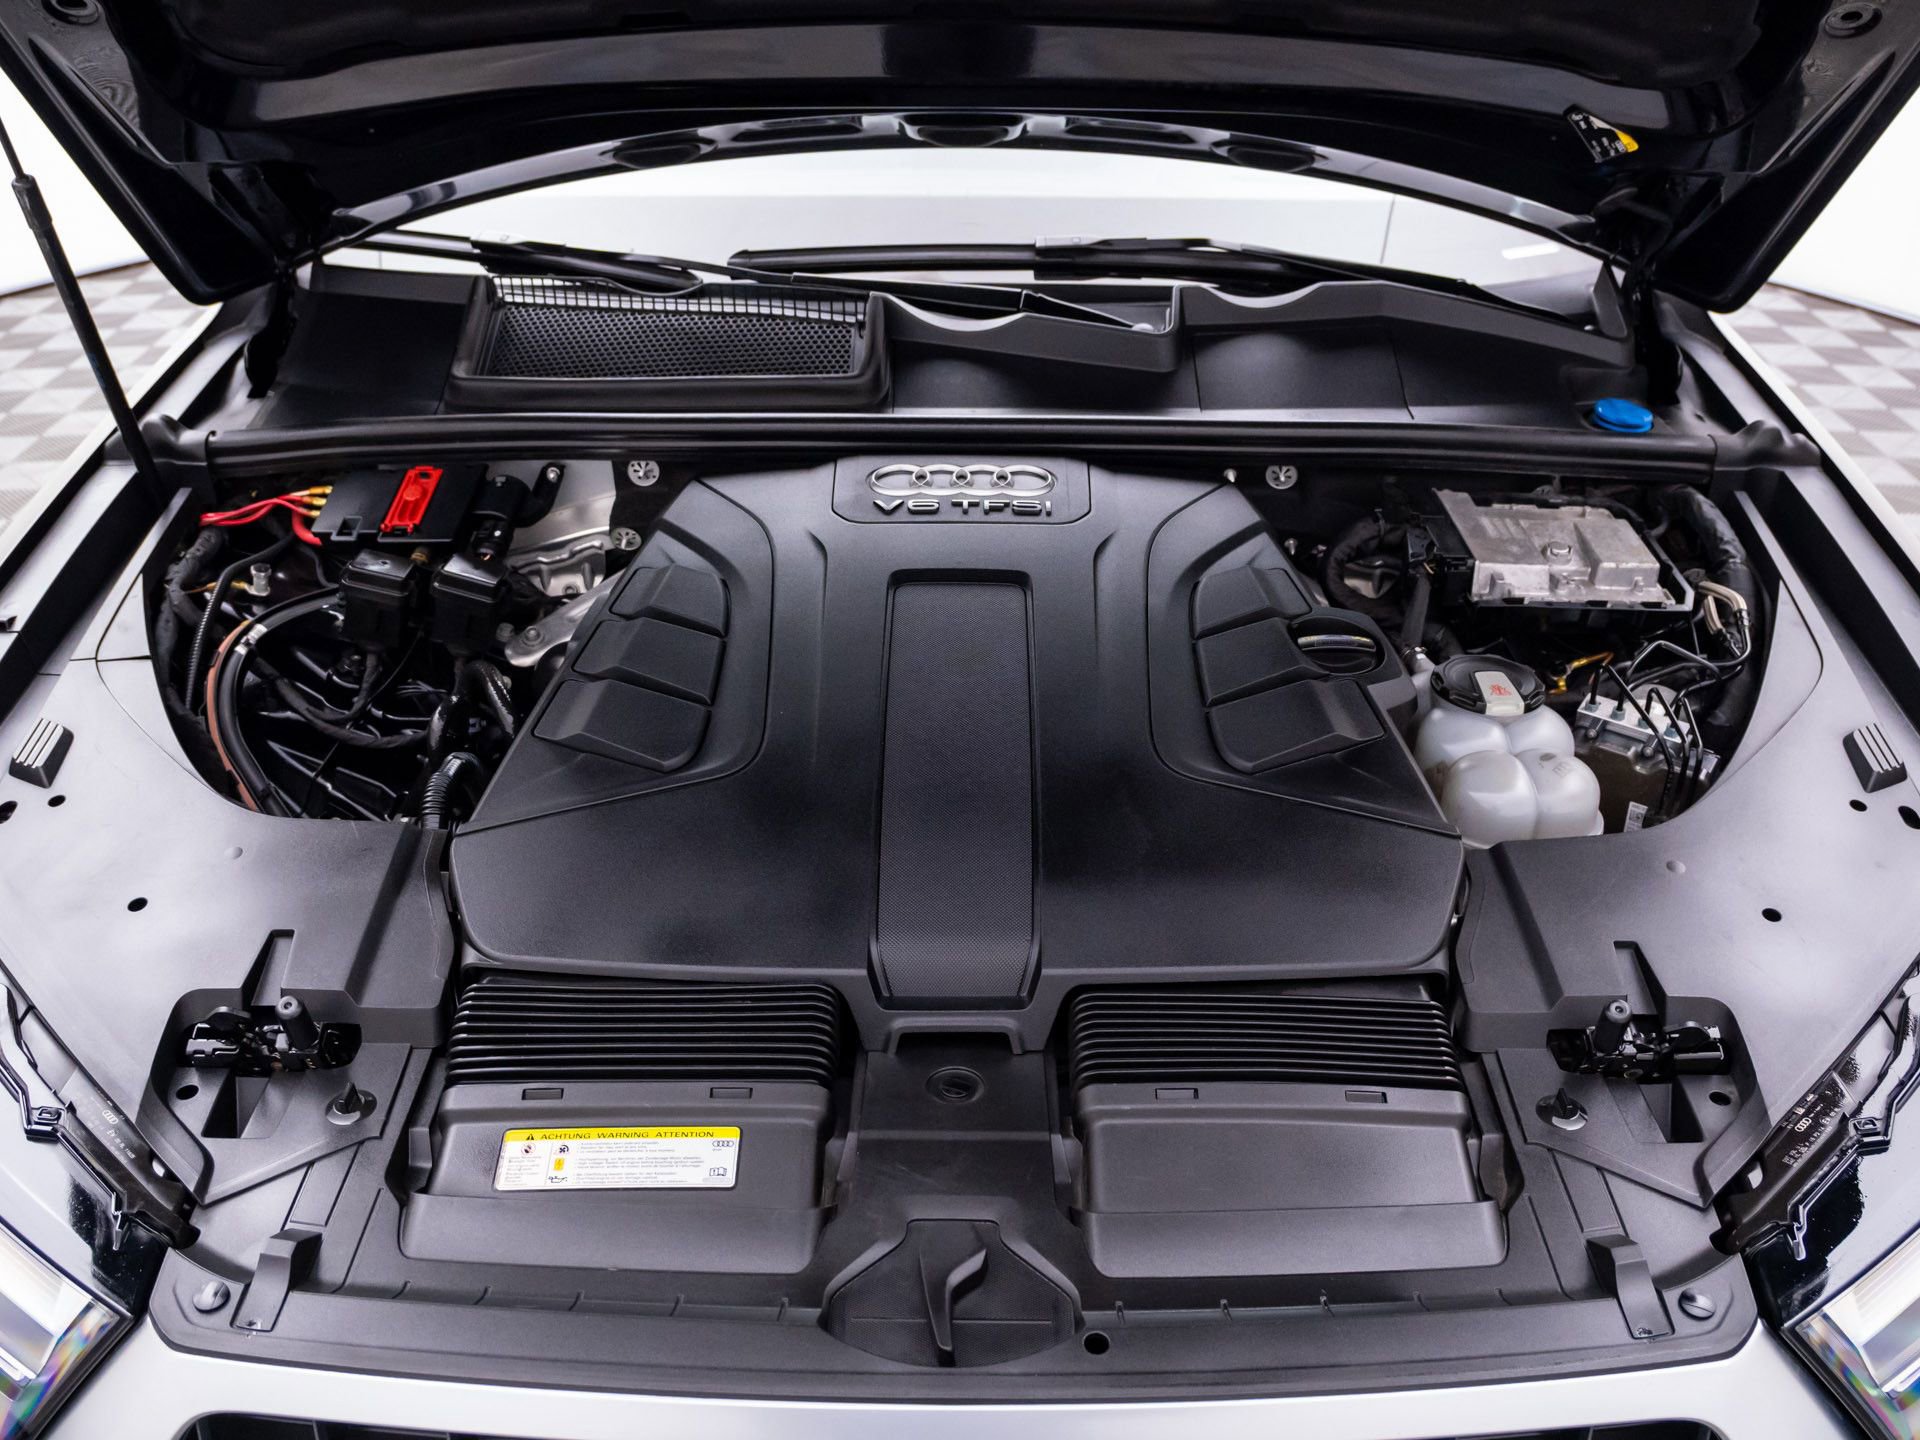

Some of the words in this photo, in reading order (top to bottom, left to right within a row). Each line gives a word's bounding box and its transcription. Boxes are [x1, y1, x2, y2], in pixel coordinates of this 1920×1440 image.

[873, 498, 940, 515] V6
[540, 1132, 591, 1140] ACHTUNG
[597, 1131, 649, 1139] WARNING
[655, 1130, 715, 1138] ATTENTION
